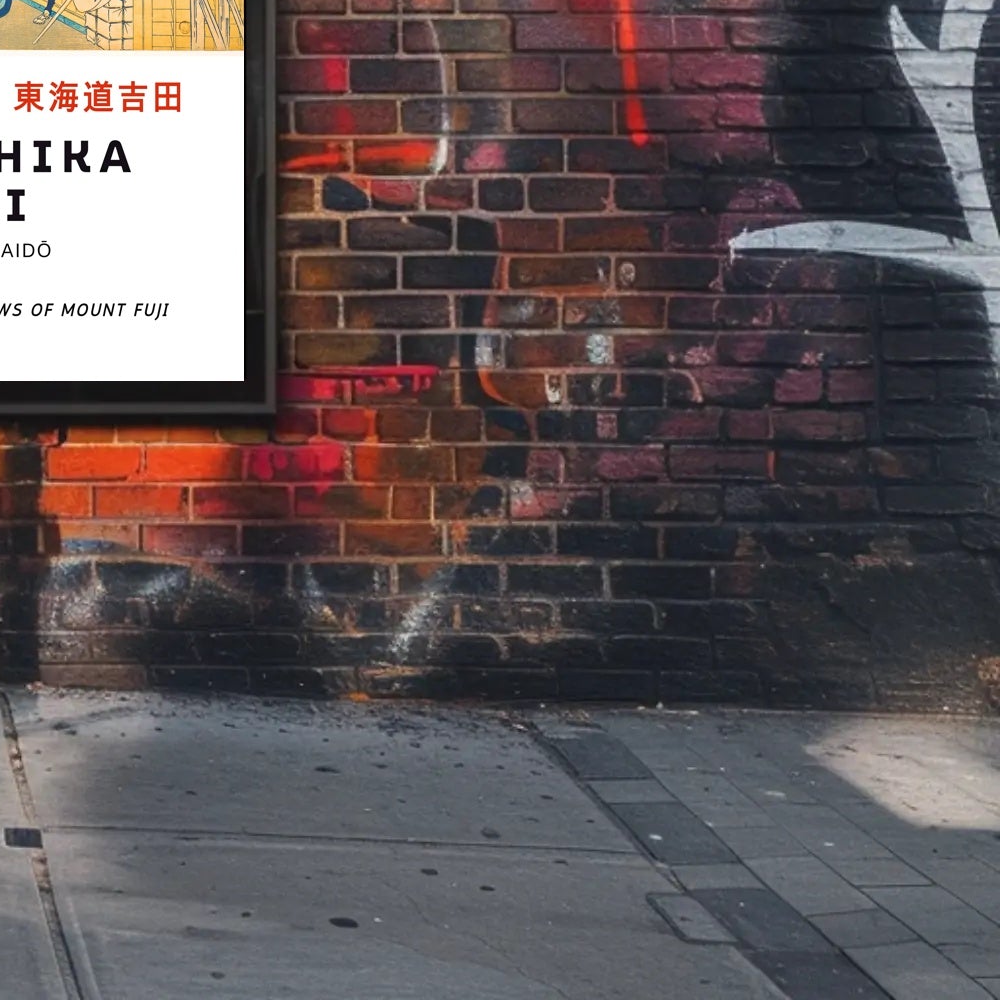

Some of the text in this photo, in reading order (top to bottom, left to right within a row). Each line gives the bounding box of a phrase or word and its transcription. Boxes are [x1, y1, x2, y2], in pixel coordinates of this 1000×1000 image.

[14, 80, 181, 112] 東海道吉田
[31, 303, 54, 317] OF
[61, 303, 126, 317] MOUNT
[134, 303, 169, 320] FUJI
